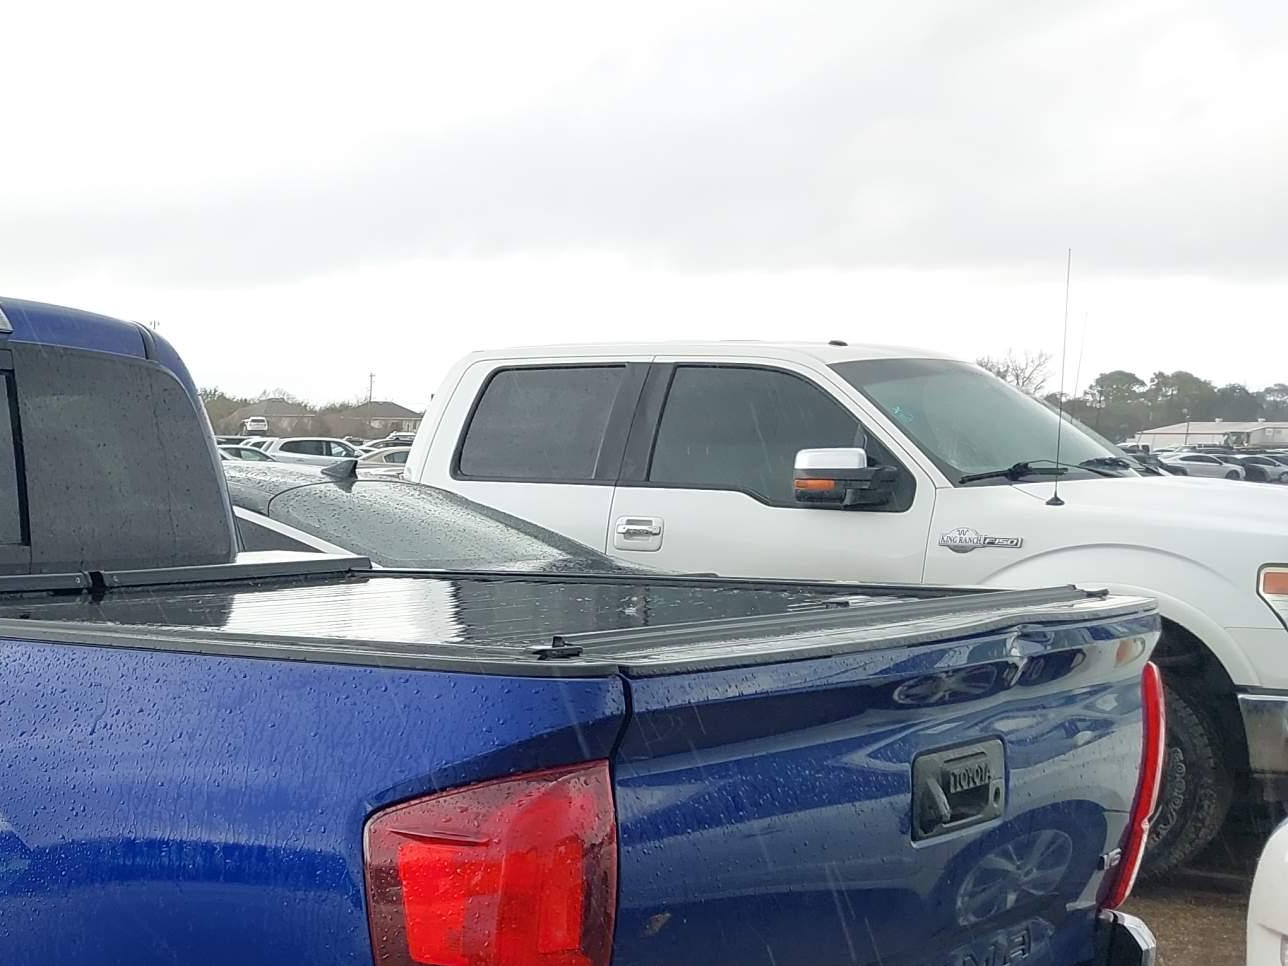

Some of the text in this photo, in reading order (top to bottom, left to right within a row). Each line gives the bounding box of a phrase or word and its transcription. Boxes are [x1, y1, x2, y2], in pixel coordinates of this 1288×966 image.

[938, 535, 982, 545] KING RANCH
[950, 764, 991, 793] TOYOTA
